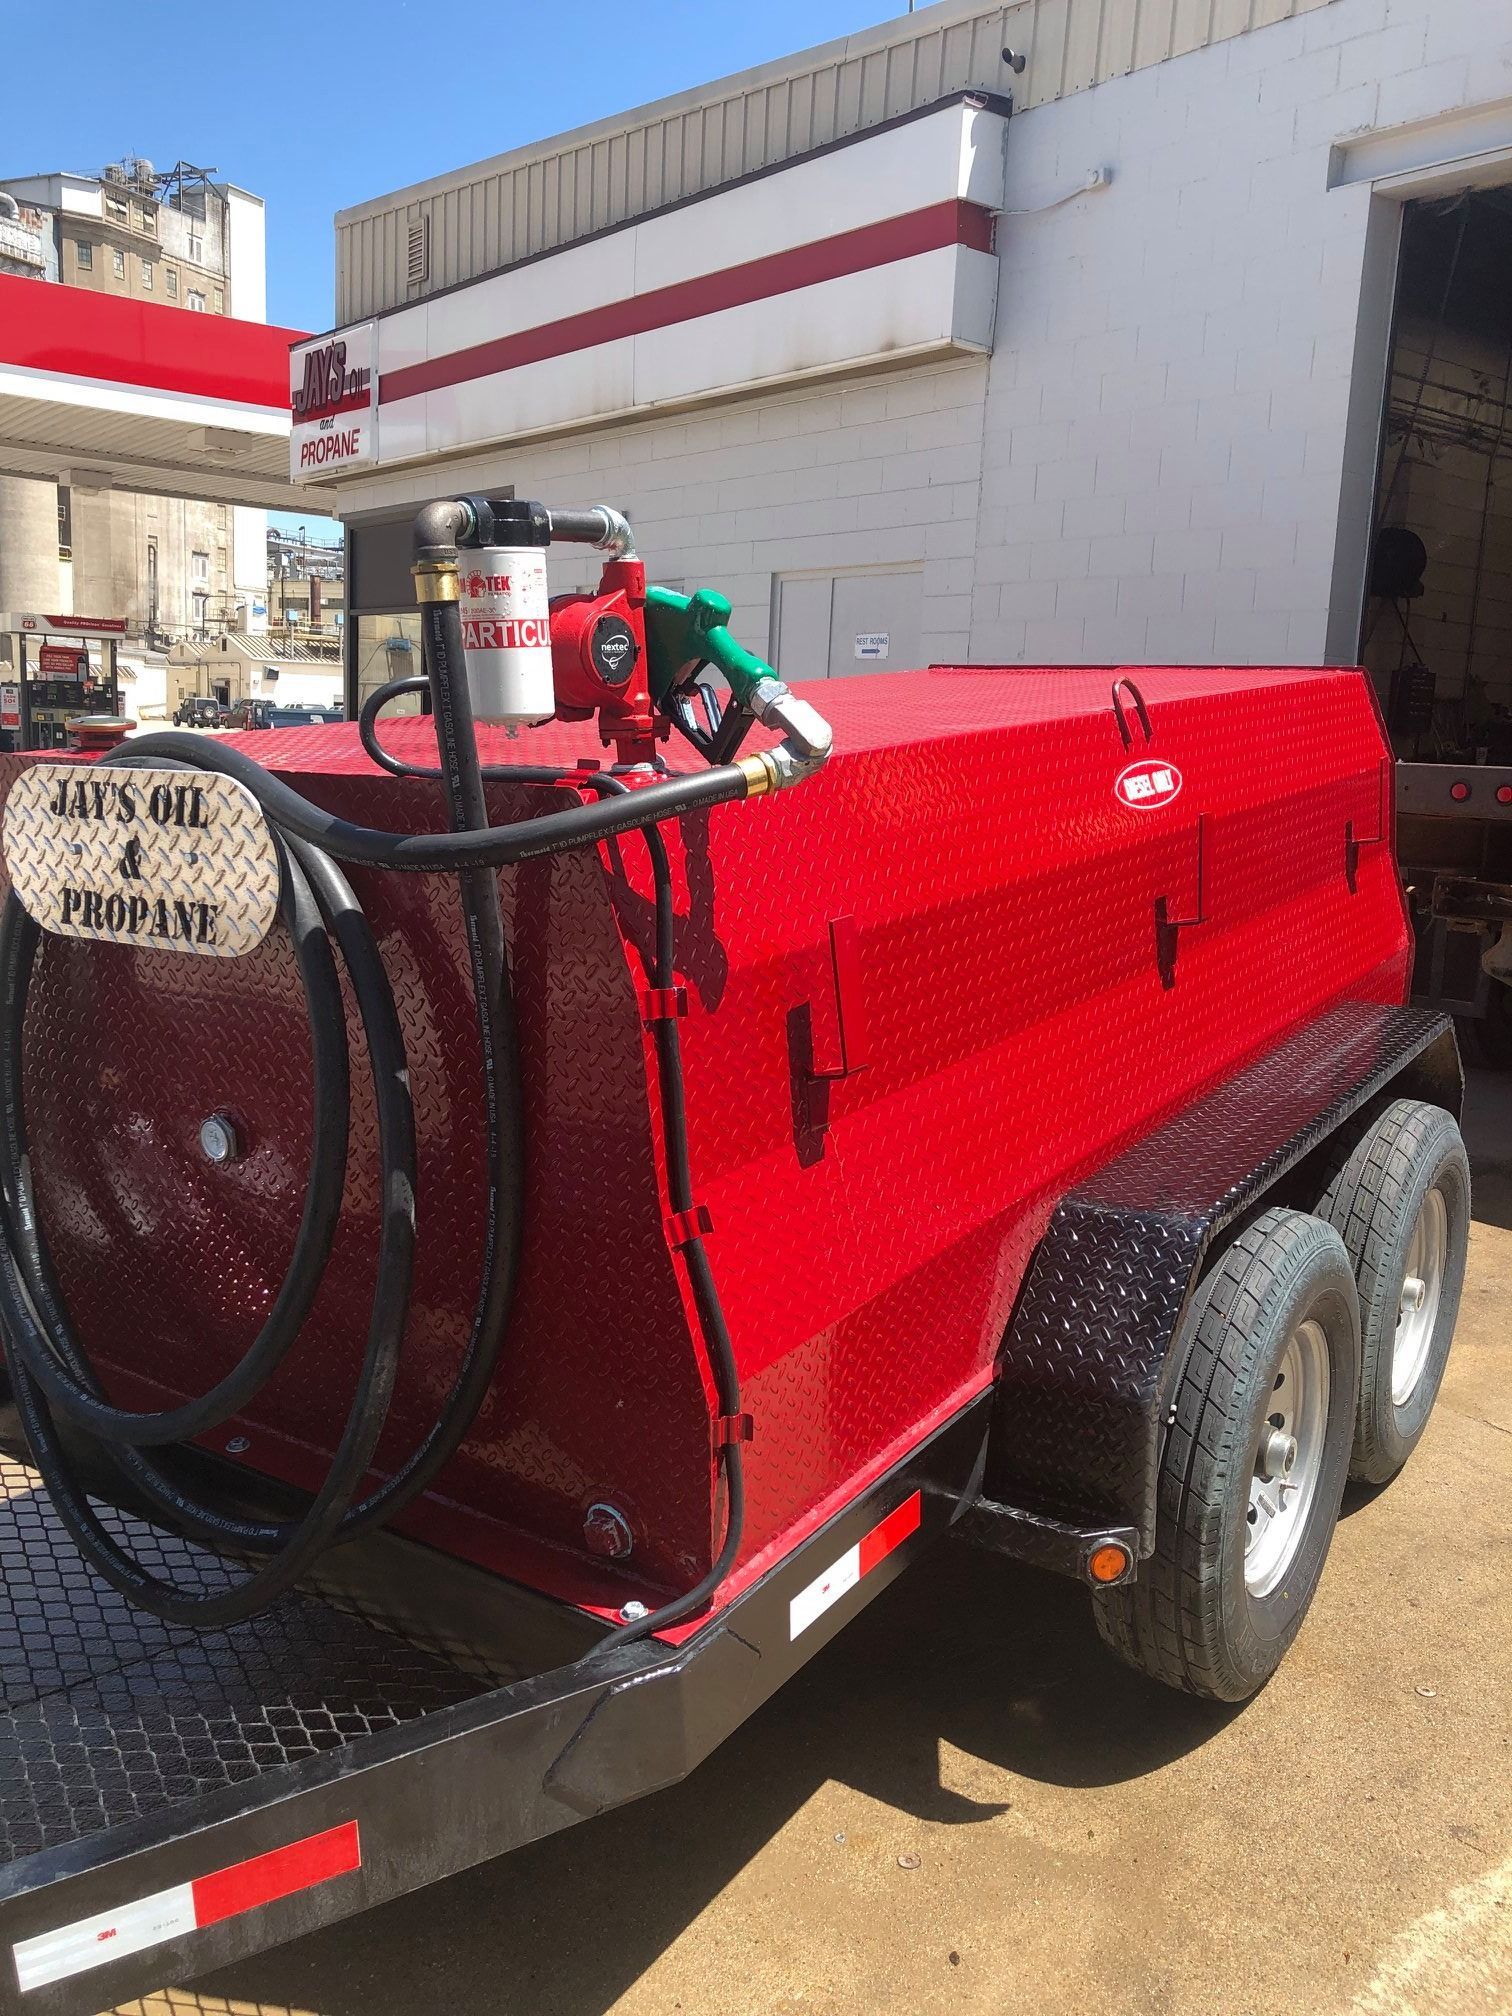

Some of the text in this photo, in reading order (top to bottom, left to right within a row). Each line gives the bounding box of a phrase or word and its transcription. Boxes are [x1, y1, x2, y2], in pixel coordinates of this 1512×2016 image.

[295, 339, 364, 416] JAY'S OIL
[319, 415, 336, 431] and
[300, 428, 361, 468] PROPANE
[601, 643, 629, 651] nextec
[443, 711, 456, 749] GASOLINE
[448, 751, 459, 772] HOSE
[49, 778, 209, 829] JAY'S OIL
[519, 845, 551, 858] Thermoid
[568, 827, 609, 849] PUMPFLEX
[616, 814, 652, 833] GASOLINE
[653, 807, 673, 821] HOSE
[698, 793, 719, 806] MADE
[725, 788, 739, 799] USA
[119, 834, 142, 880] &
[60, 887, 219, 945] PROPANE
[97, 1927, 118, 1941] 3M
